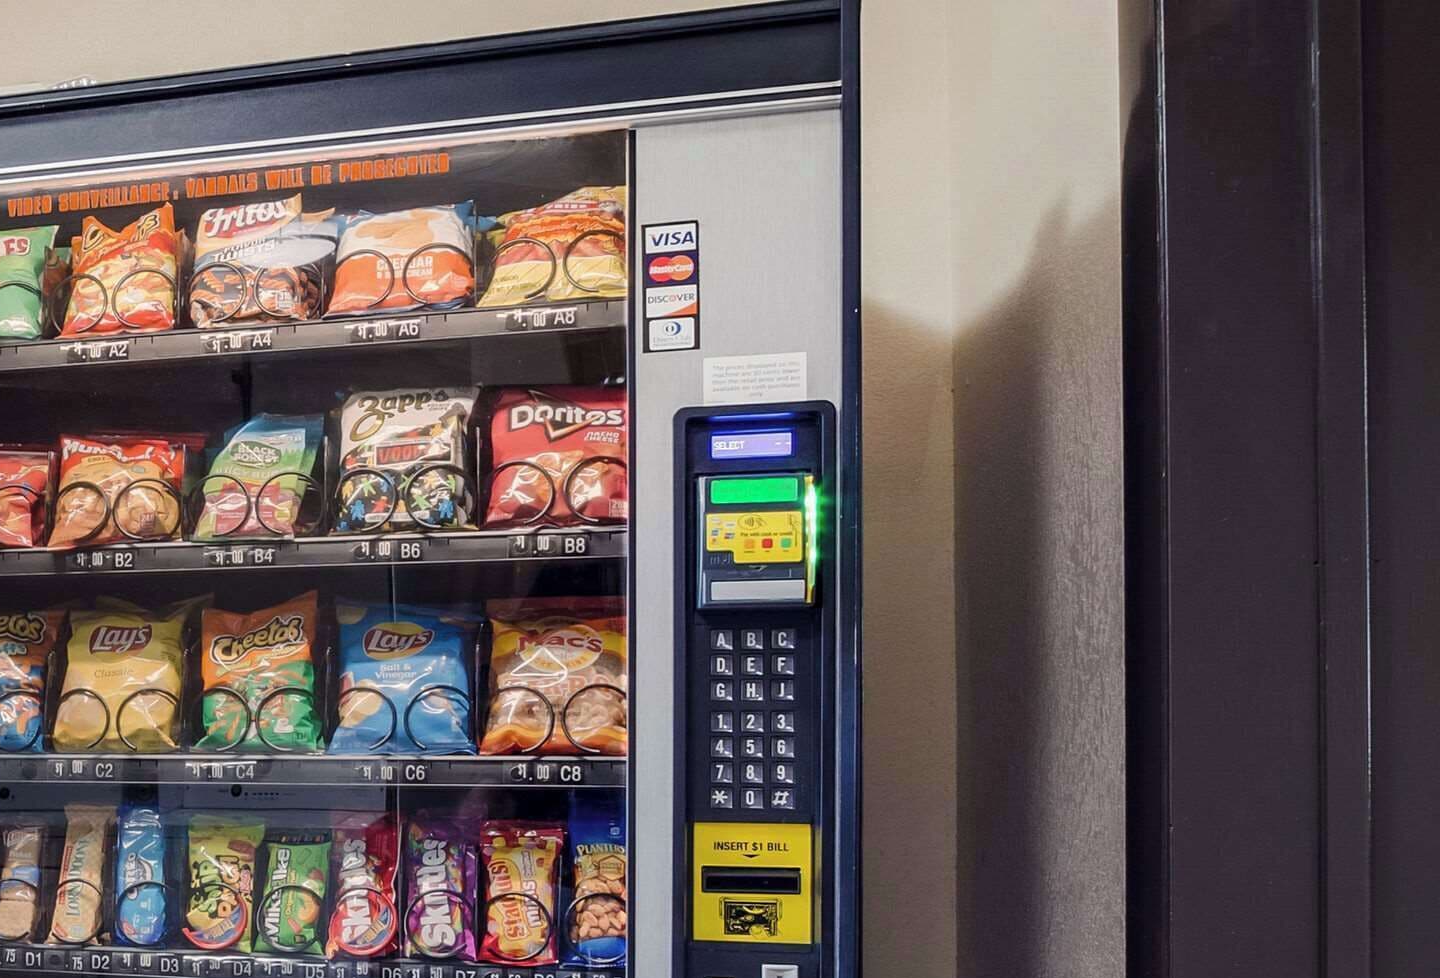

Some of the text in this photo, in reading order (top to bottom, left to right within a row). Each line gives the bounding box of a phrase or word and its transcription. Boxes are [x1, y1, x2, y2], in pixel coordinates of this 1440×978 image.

[8, 195, 52, 217] VIDEO
[186, 172, 257, 198] VANDALS
[265, 167, 304, 190] WILL
[312, 165, 332, 186] BE
[339, 152, 449, 183] PROSECUTED
[651, 231, 694, 246] VISA
[647, 293, 695, 305] DISCOVER
[554, 311, 575, 325] A8
[398, 323, 419, 336] A6
[252, 333, 272, 347] A4
[110, 343, 127, 357] A2
[511, 405, 623, 431] Doritos
[713, 441, 744, 450] SELECT
[401, 543, 421, 558] B6
[565, 537, 586, 552] B8
[115, 552, 133, 567] B2
[255, 549, 273, 563] B4
[93, 626, 151, 652] Lay's
[212, 616, 303, 663] Cheetos
[717, 632, 786, 646] A B C
[717, 658, 785, 672] D E F
[716, 683, 784, 697] G H J
[717, 715, 785, 728] 1 2 3
[715, 740, 785, 754] 4 5 6
[95, 763, 113, 778] C2
[236, 764, 254, 779] C4
[405, 765, 425, 781] C6
[561, 766, 581, 781] C8
[716, 765, 785, 779] 7 8 9
[746, 792, 754, 805] 0
[713, 842, 789, 852] INSERT $1 BILL
[26, 952, 41, 967] D1
[92, 954, 109, 969] D2
[160, 958, 179, 973] D3
[234, 962, 252, 976] D4
[305, 964, 325, 978] D5
